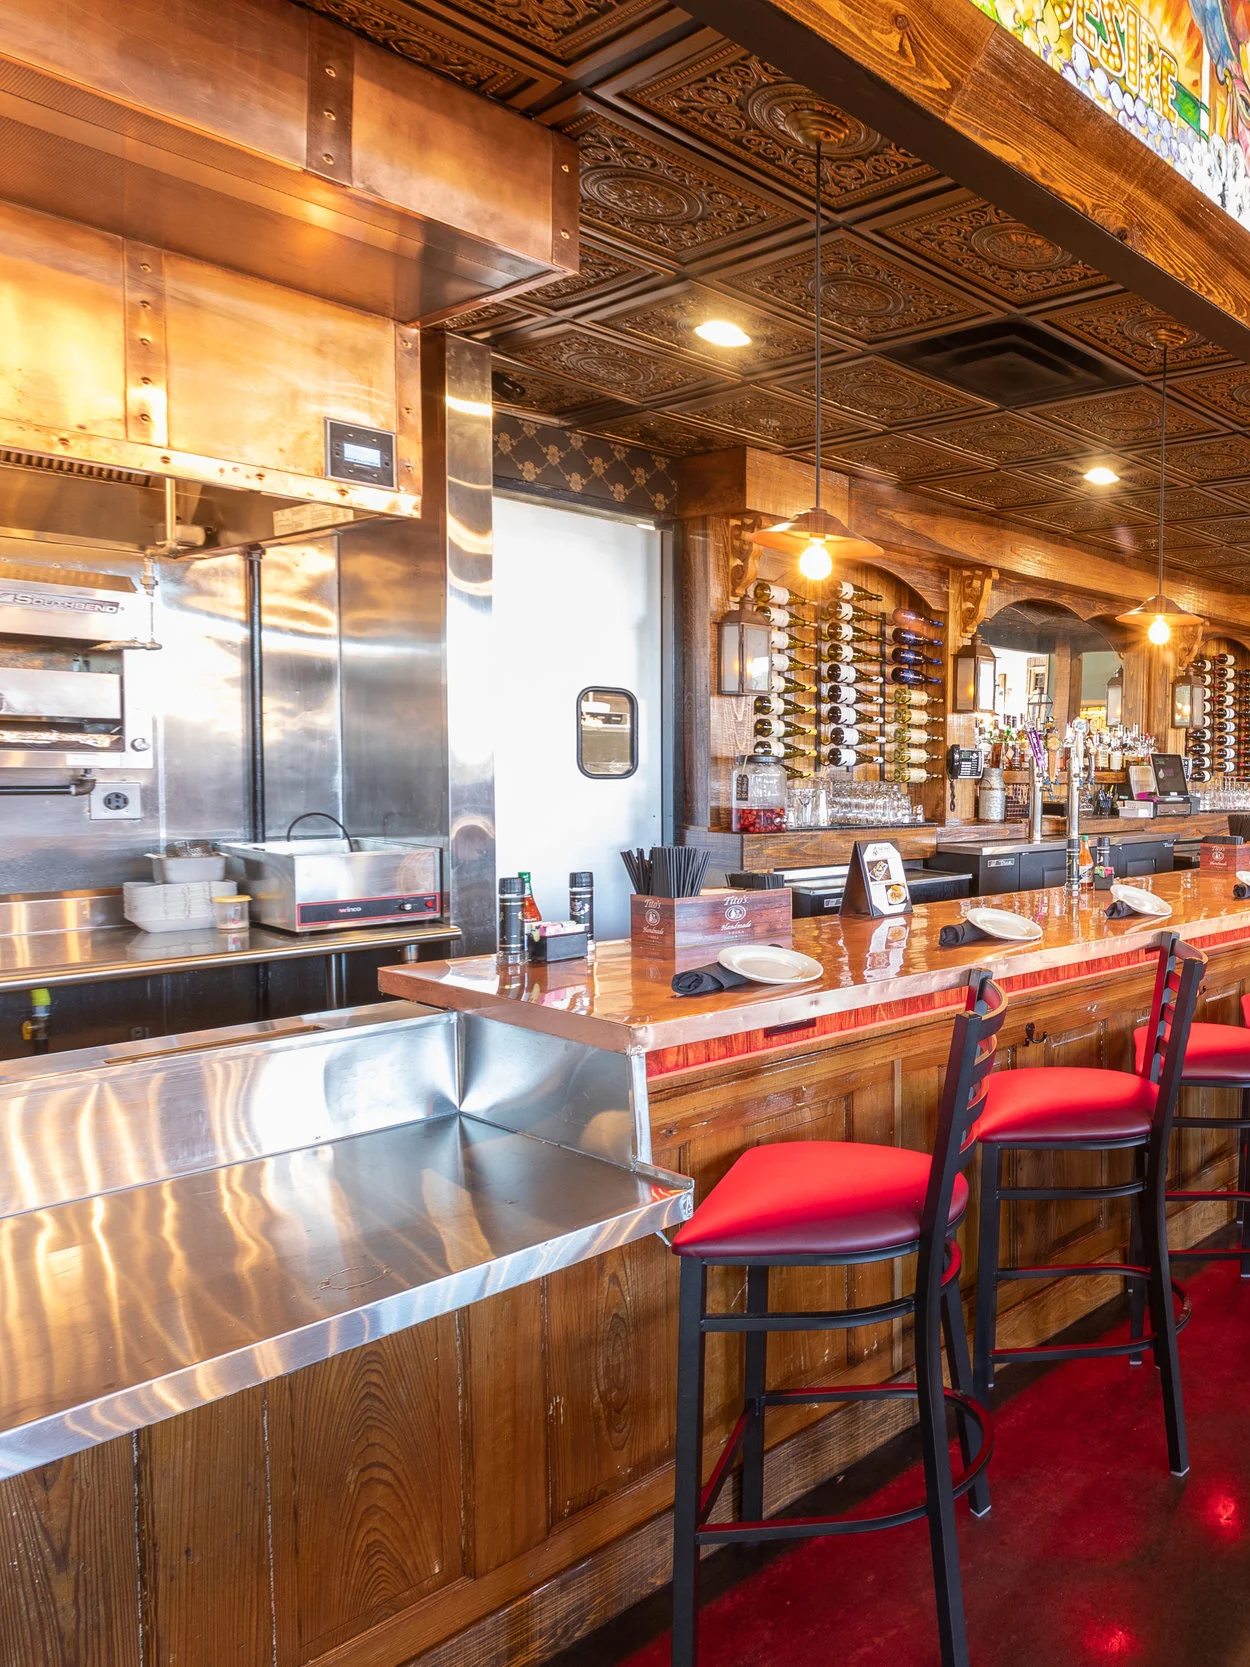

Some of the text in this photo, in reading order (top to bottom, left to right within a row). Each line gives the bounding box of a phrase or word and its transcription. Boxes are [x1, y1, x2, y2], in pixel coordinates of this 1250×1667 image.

[14, 593, 118, 614] SOUTHBEND
[644, 899, 661, 909] Tito's
[724, 895, 748, 906] Tito's
